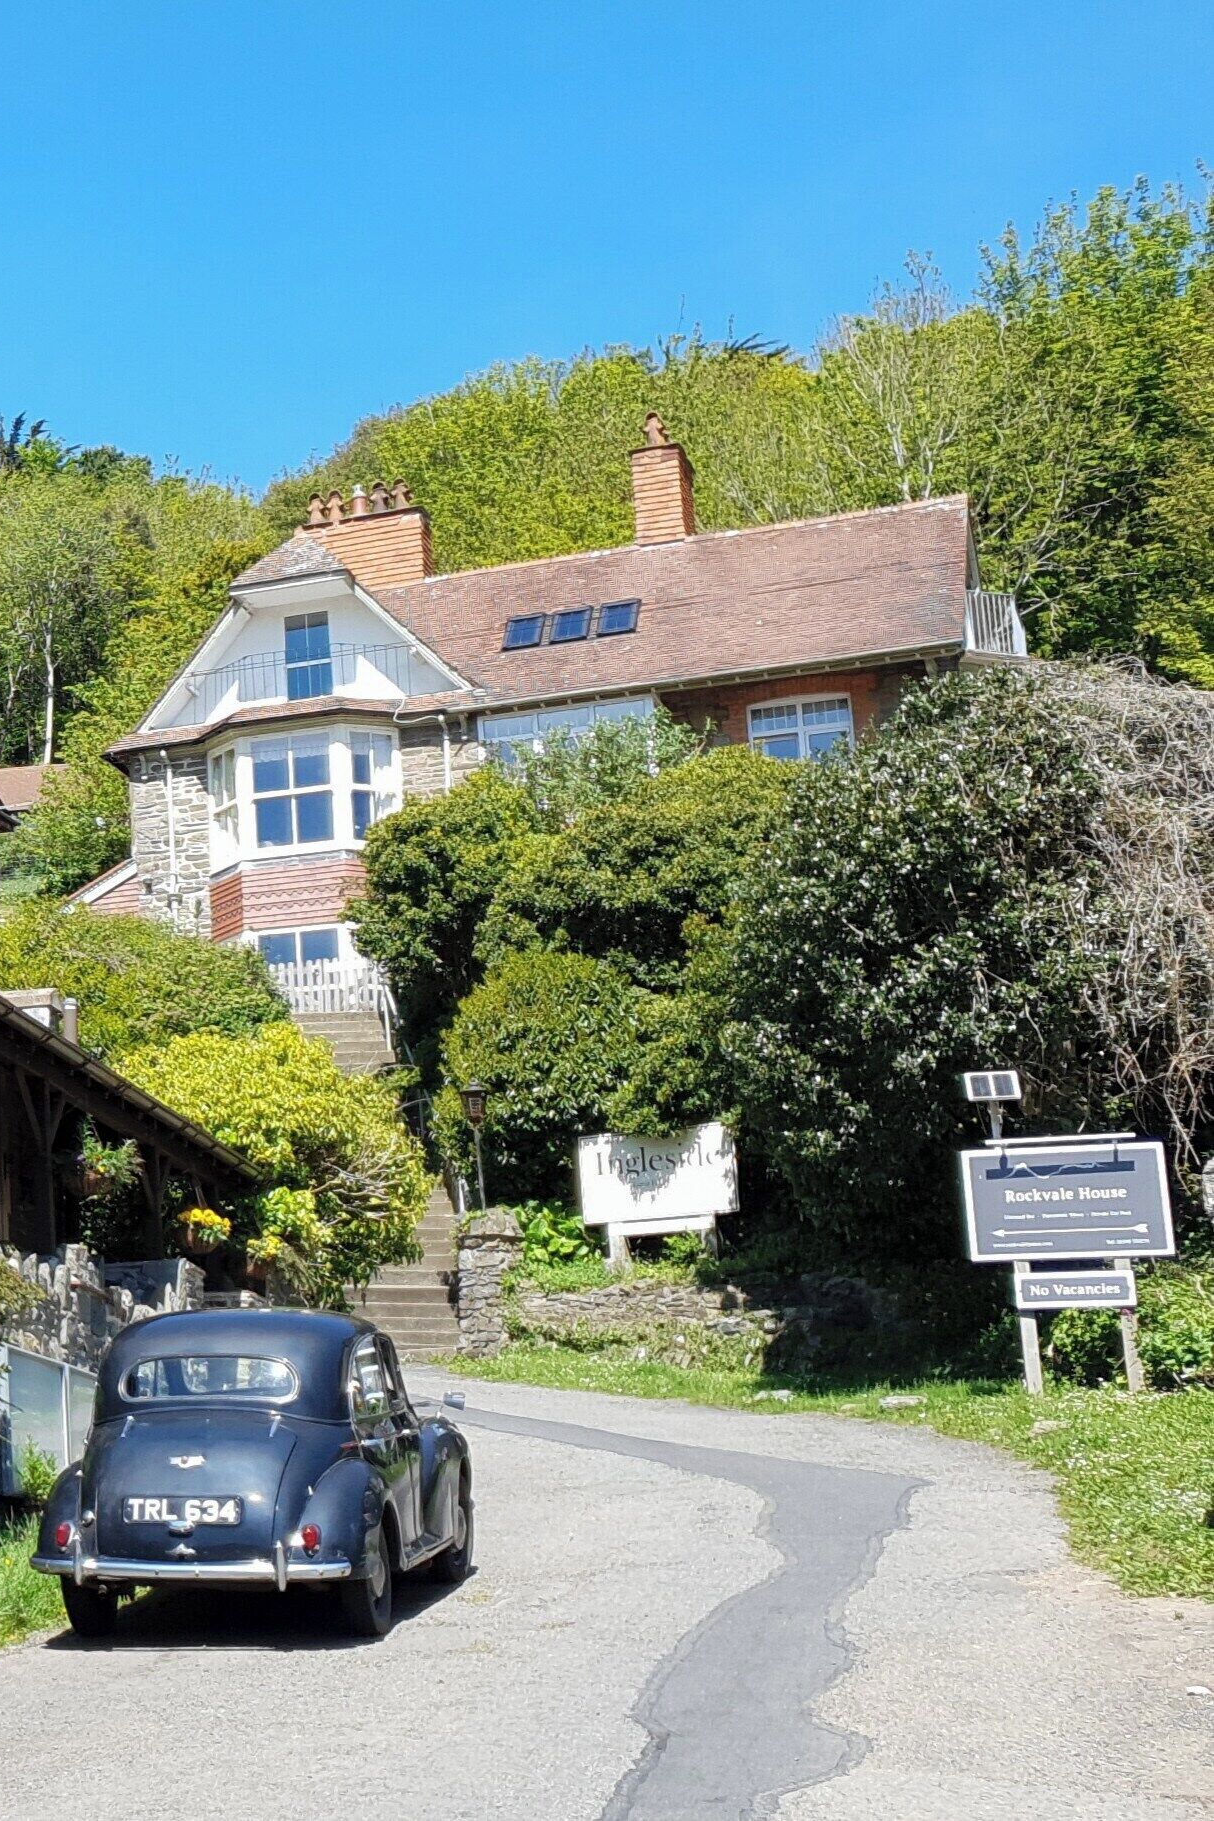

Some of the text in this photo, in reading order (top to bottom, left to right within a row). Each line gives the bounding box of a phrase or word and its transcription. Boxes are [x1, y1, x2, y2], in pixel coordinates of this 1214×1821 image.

[1004, 1186, 1128, 1204] Rockvale House
[1029, 1282, 1121, 1296] No Vacancies
[128, 1499, 237, 1523] TRL 634
